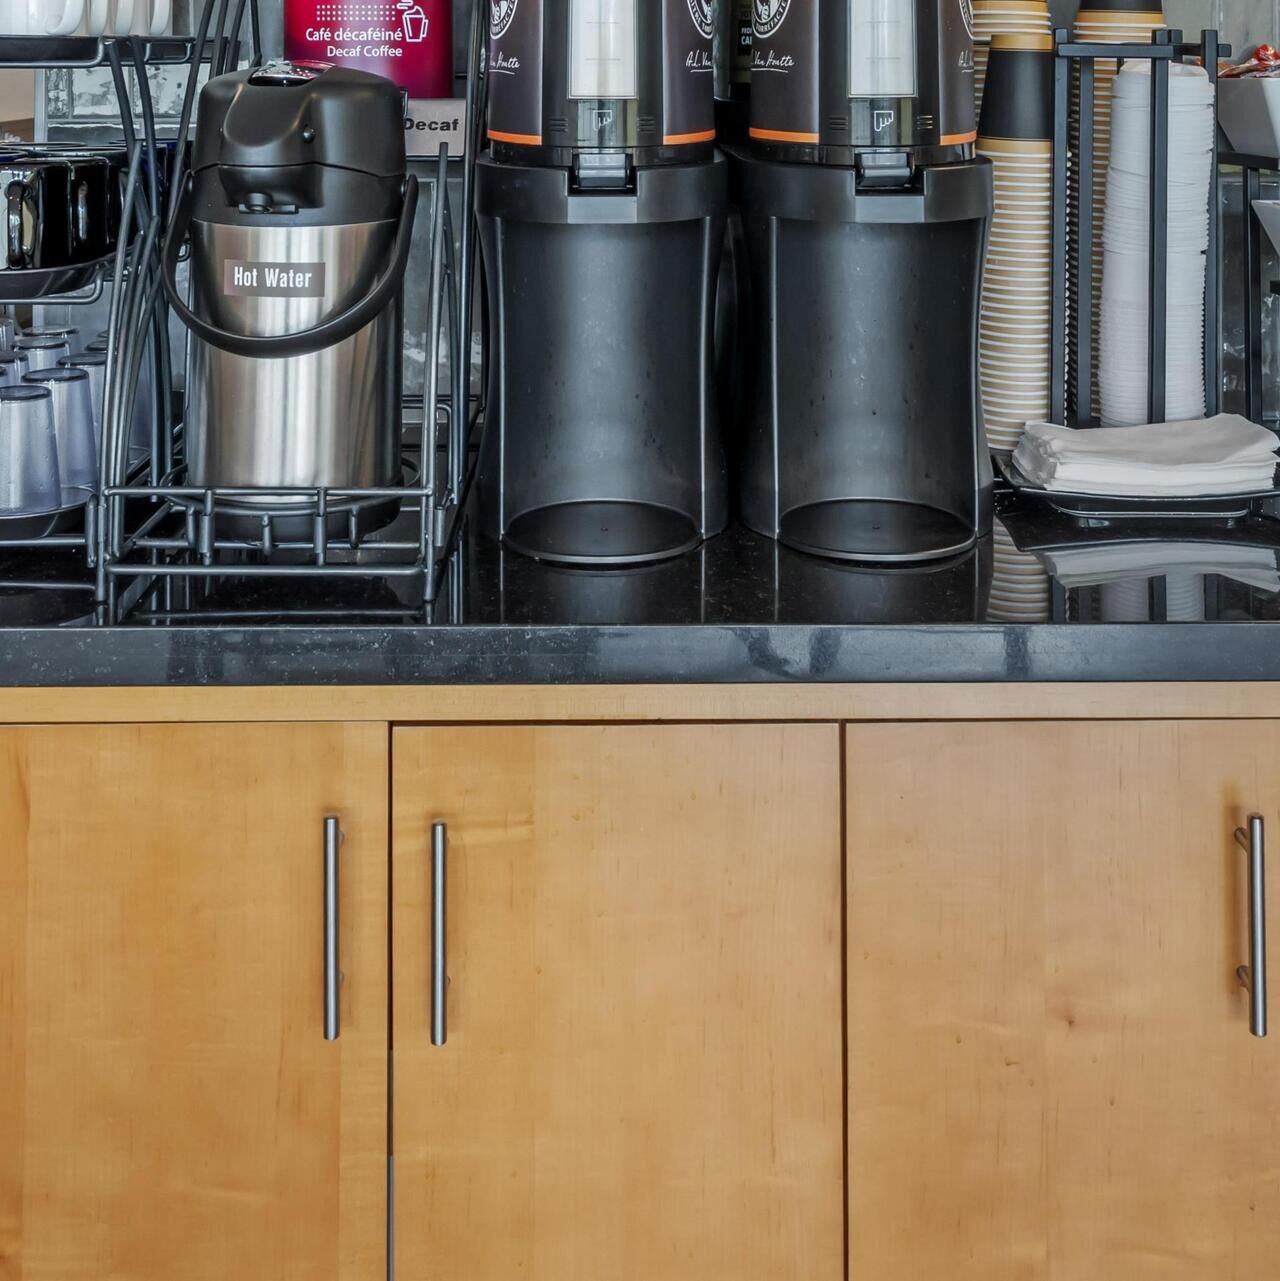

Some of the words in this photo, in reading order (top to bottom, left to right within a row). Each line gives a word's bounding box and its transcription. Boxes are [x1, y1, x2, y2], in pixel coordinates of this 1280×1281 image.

[305, 27, 331, 41] Café
[334, 26, 403, 42] décaféiné
[327, 45, 361, 57] Decaf
[363, 45, 403, 57] Coffee
[766, 50, 795, 67] Houtte
[496, 51, 520, 69] Houtte
[404, 118, 460, 131] Decaf
[234, 266, 258, 287] Hot
[264, 267, 313, 288] Water
